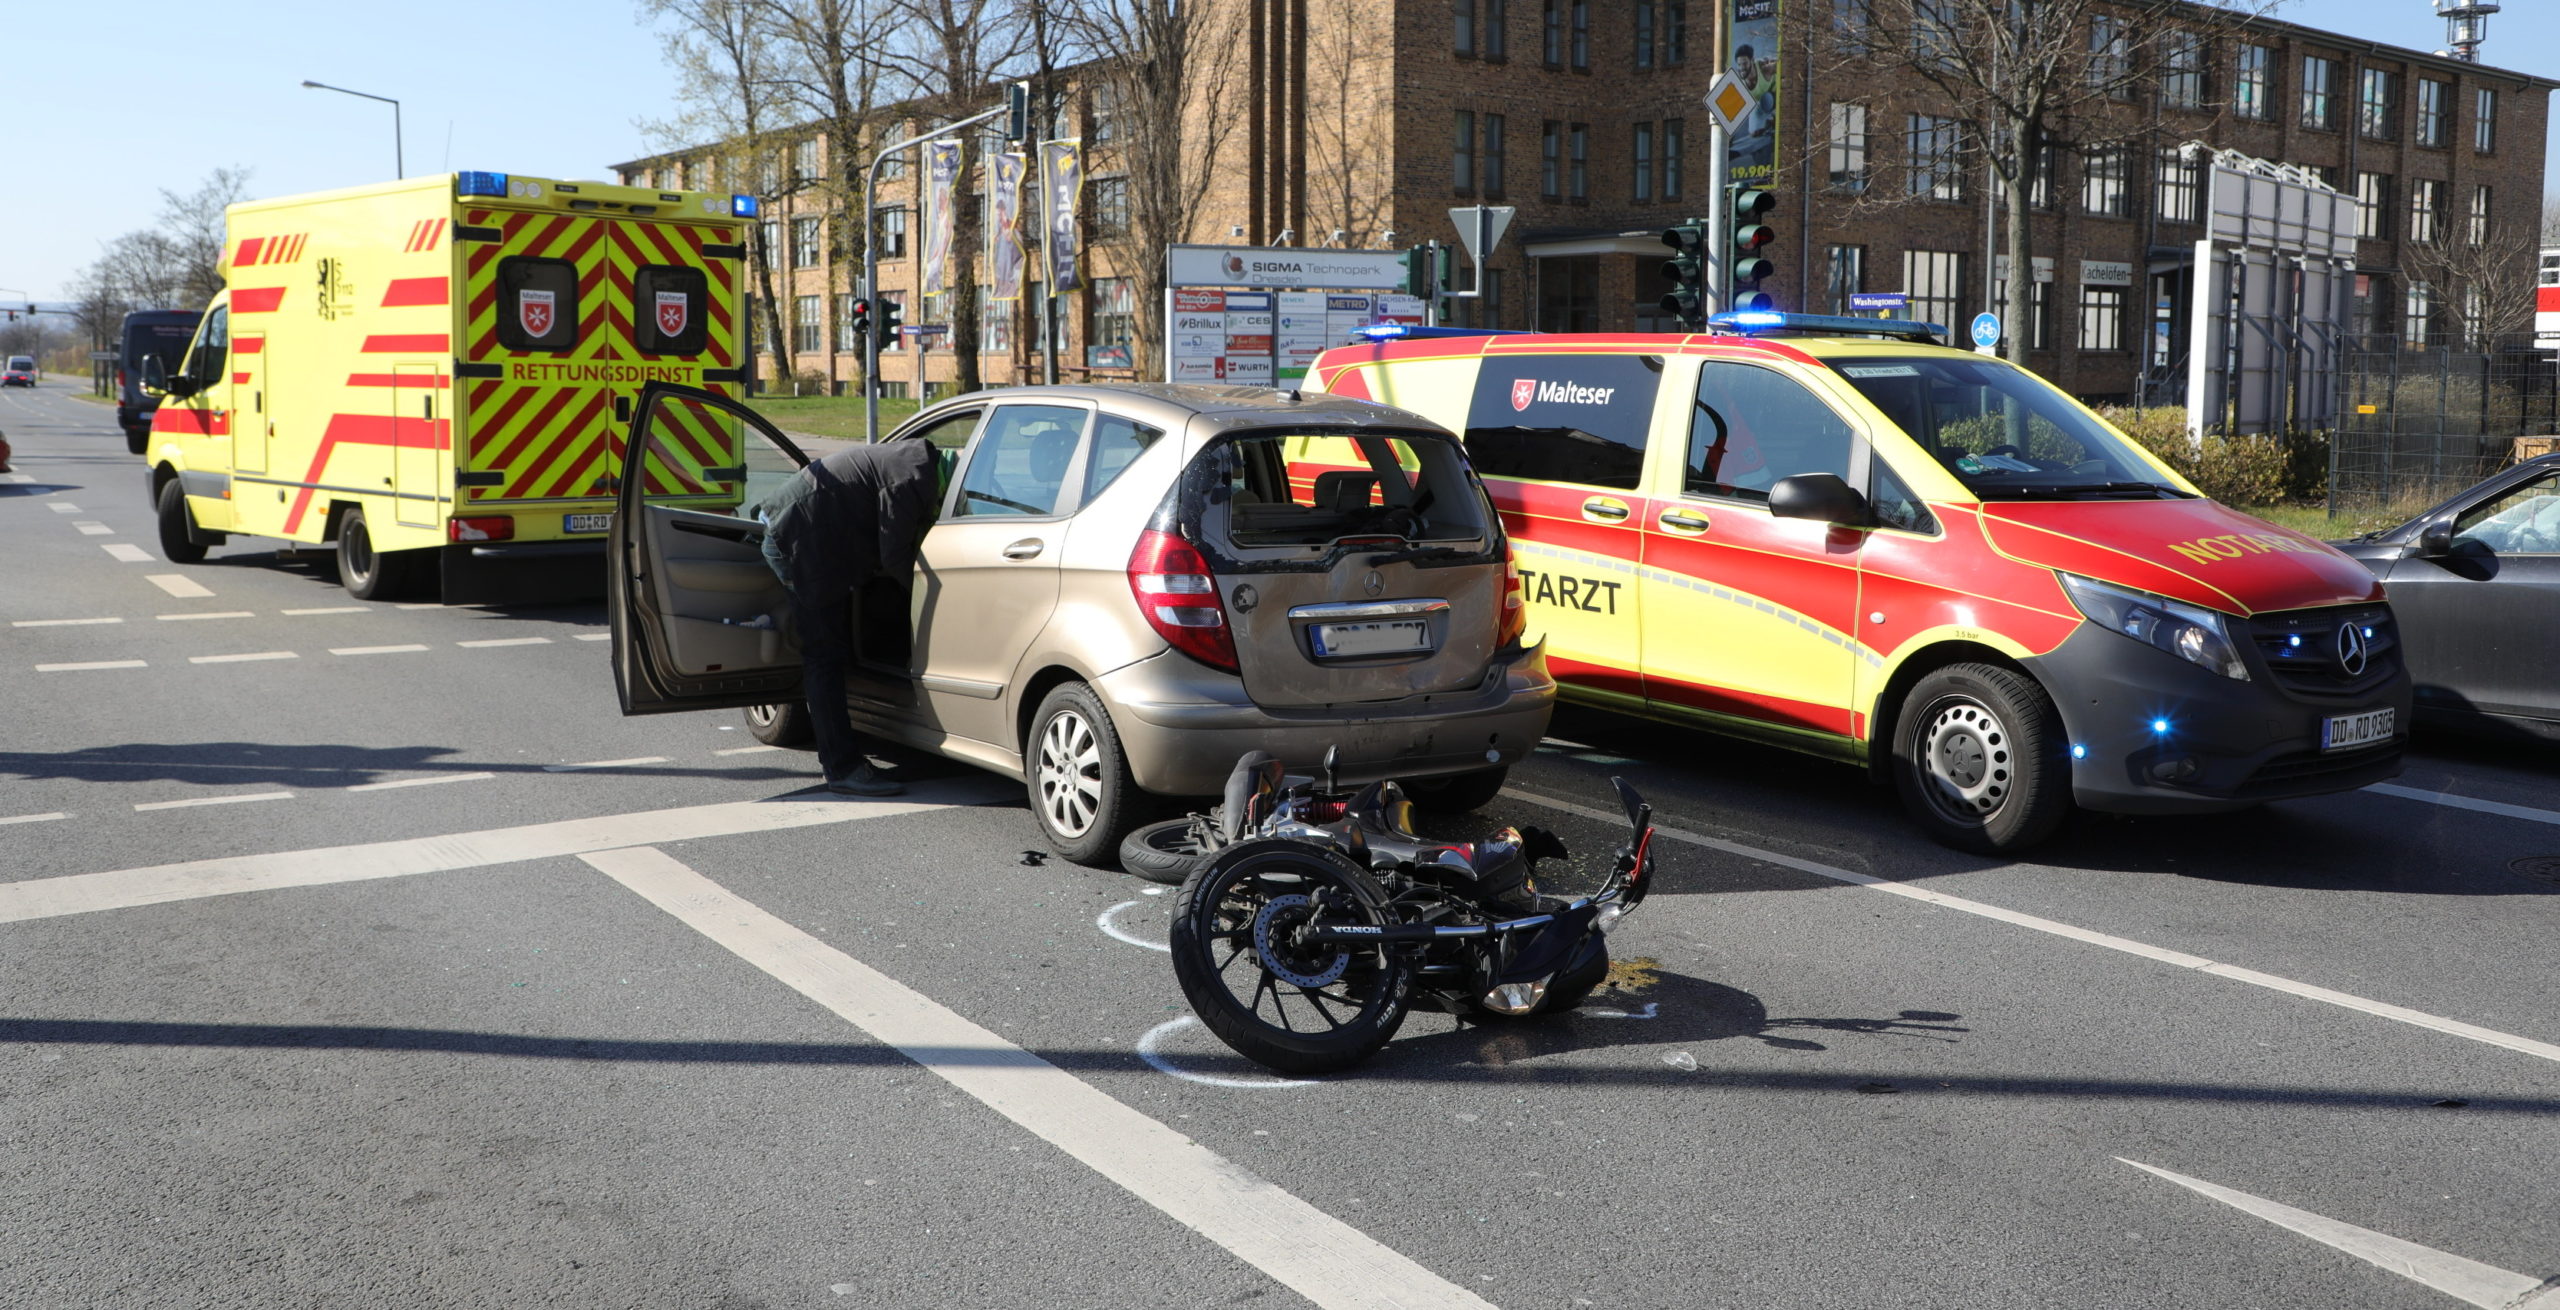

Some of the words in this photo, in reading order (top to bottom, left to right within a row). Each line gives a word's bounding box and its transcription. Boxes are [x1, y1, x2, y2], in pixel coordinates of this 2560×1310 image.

[1252, 262, 1303, 273] SIGMA
[1306, 263, 1382, 276] Technopark
[2081, 264, 2127, 280] Kachelöfen
[1252, 274, 1303, 284] Dresden
[521, 292, 553, 300] Malteser
[657, 293, 686, 302] Malteser
[1328, 299, 1367, 310] METRO
[1853, 297, 1904, 307] Washingtonstr.
[1188, 317, 1222, 329] Brillux
[1247, 316, 1271, 325] CES
[1238, 363, 1269, 372] WÜRTH
[513, 363, 695, 383] RETTUNGSDIENST
[1537, 380, 1615, 405] Malteser
[1967, 631, 1980, 640] bar
[2331, 720, 2348, 744] DD
[2355, 716, 2370, 740] RD
[1331, 926, 1383, 934] HONDA
